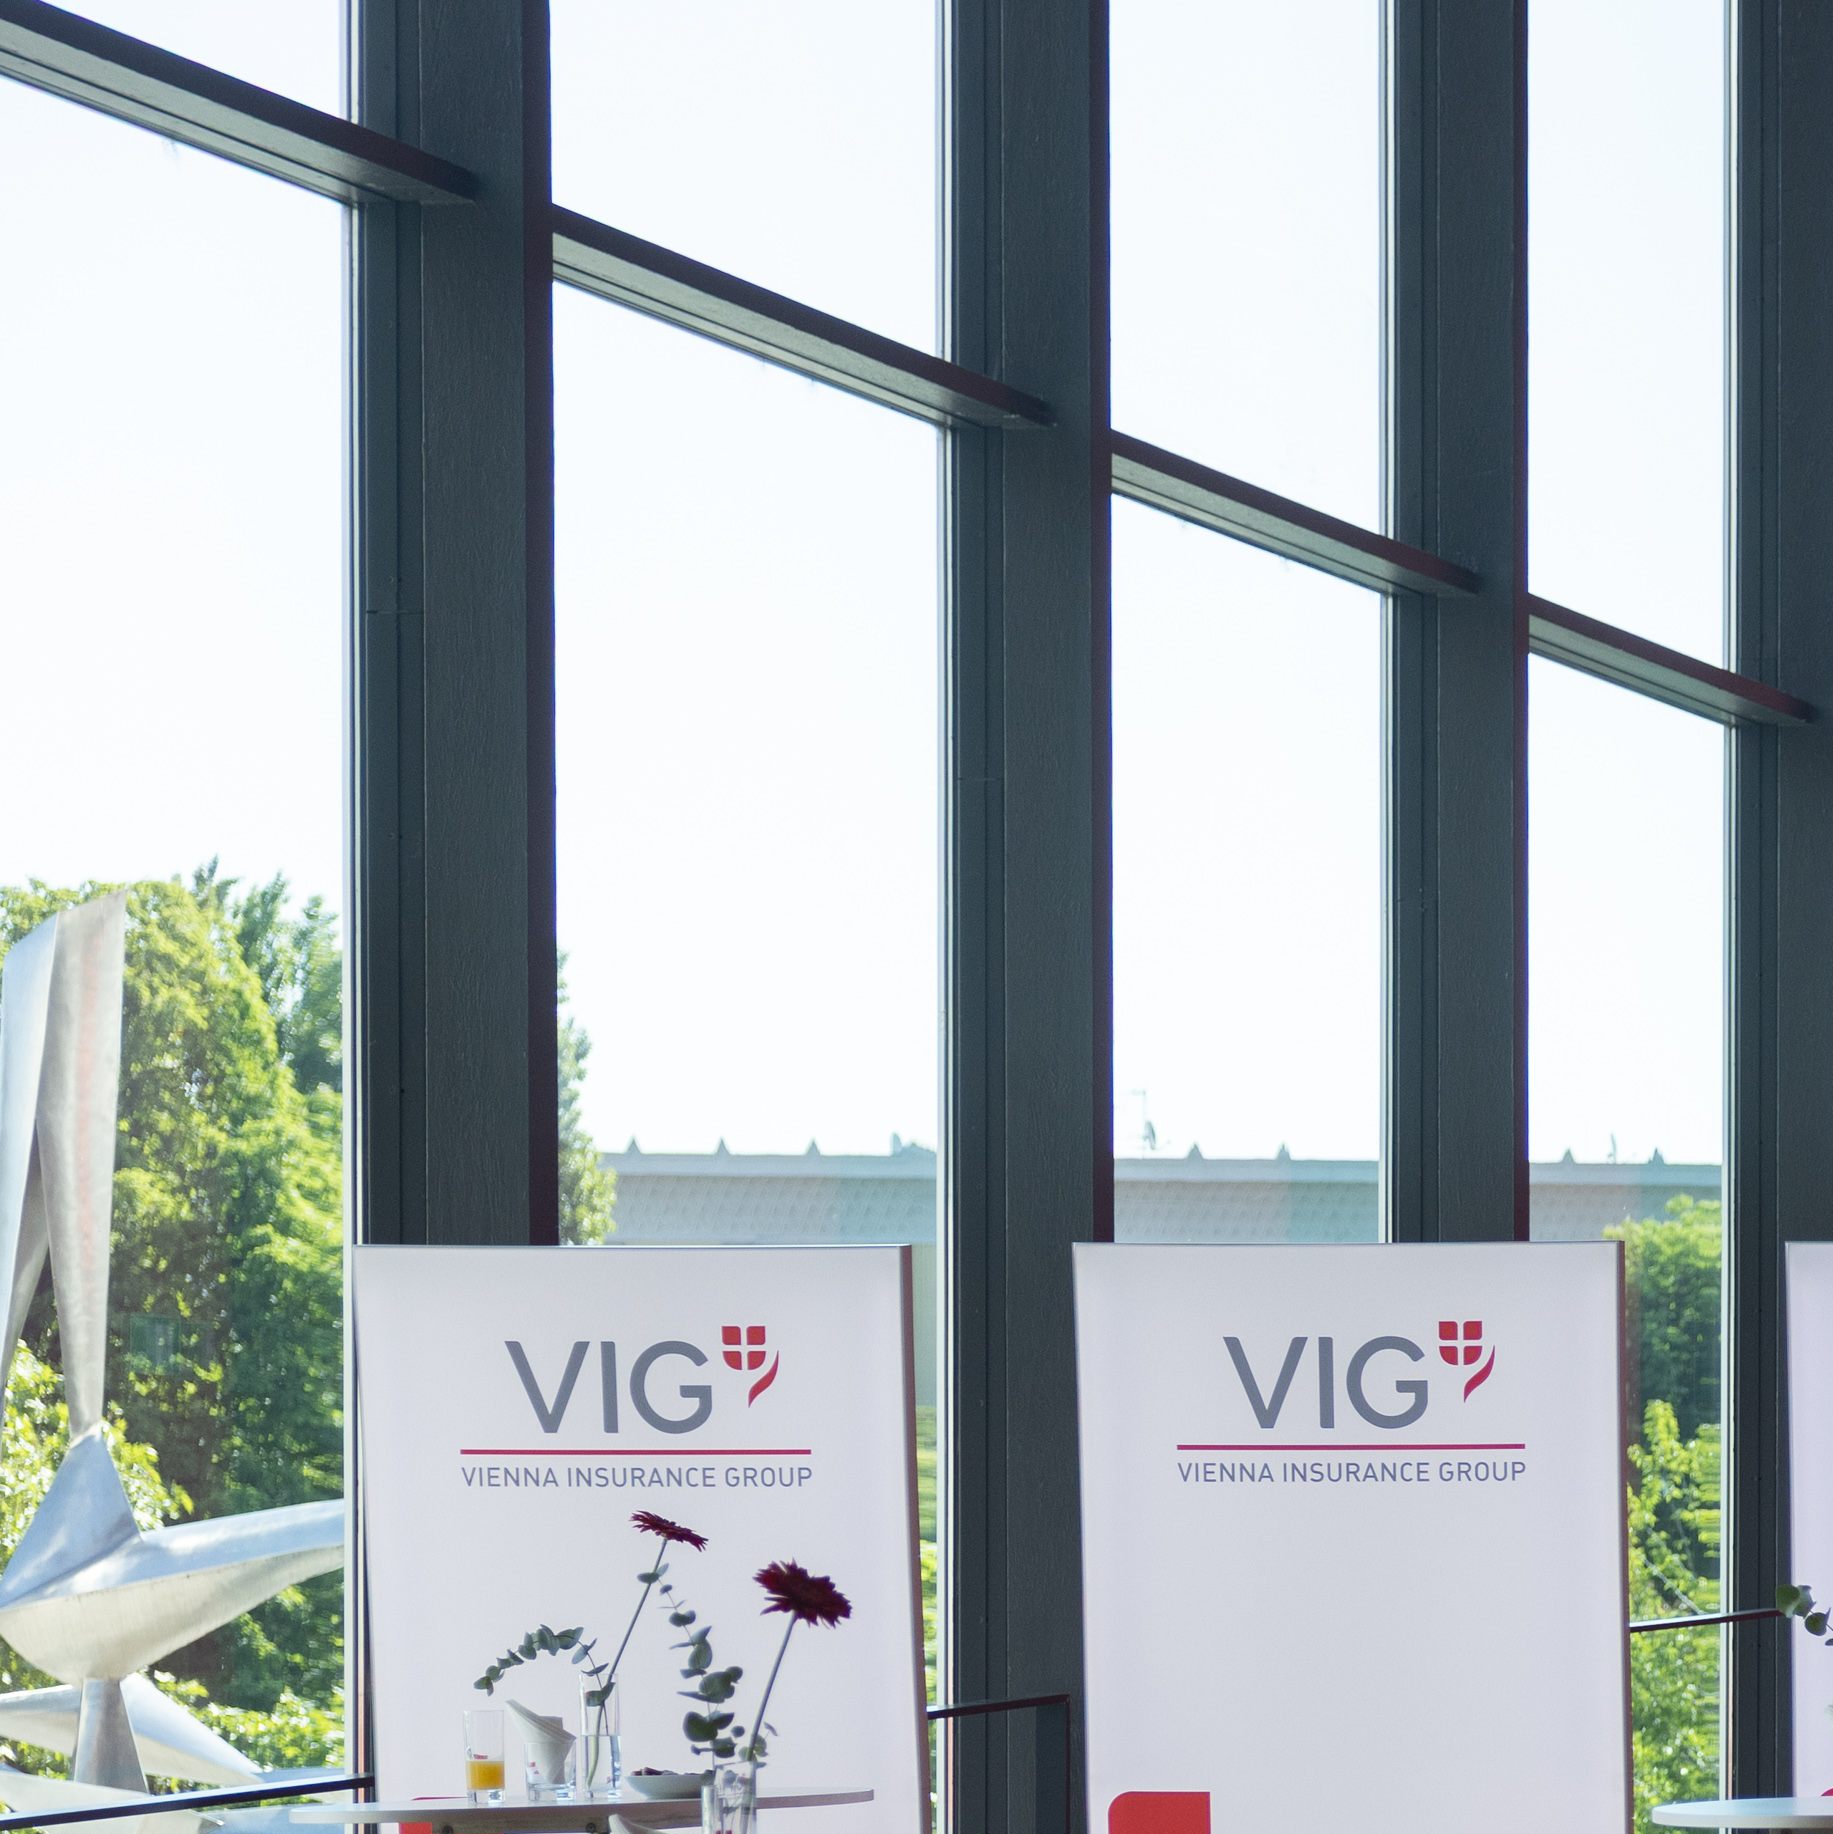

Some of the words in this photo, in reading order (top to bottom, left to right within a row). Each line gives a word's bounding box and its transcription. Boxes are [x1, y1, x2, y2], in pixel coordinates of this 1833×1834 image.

[505, 1341, 712, 1434] VIG
[1223, 1336, 1428, 1429] VIG
[460, 1467, 559, 1487] VIENNA
[567, 1467, 716, 1488] INSURANCE
[725, 1467, 812, 1487] GROUP
[1177, 1463, 1275, 1482] VIENNA
[1283, 1462, 1430, 1482] INSURANCE
[1439, 1462, 1526, 1481] GROUP
